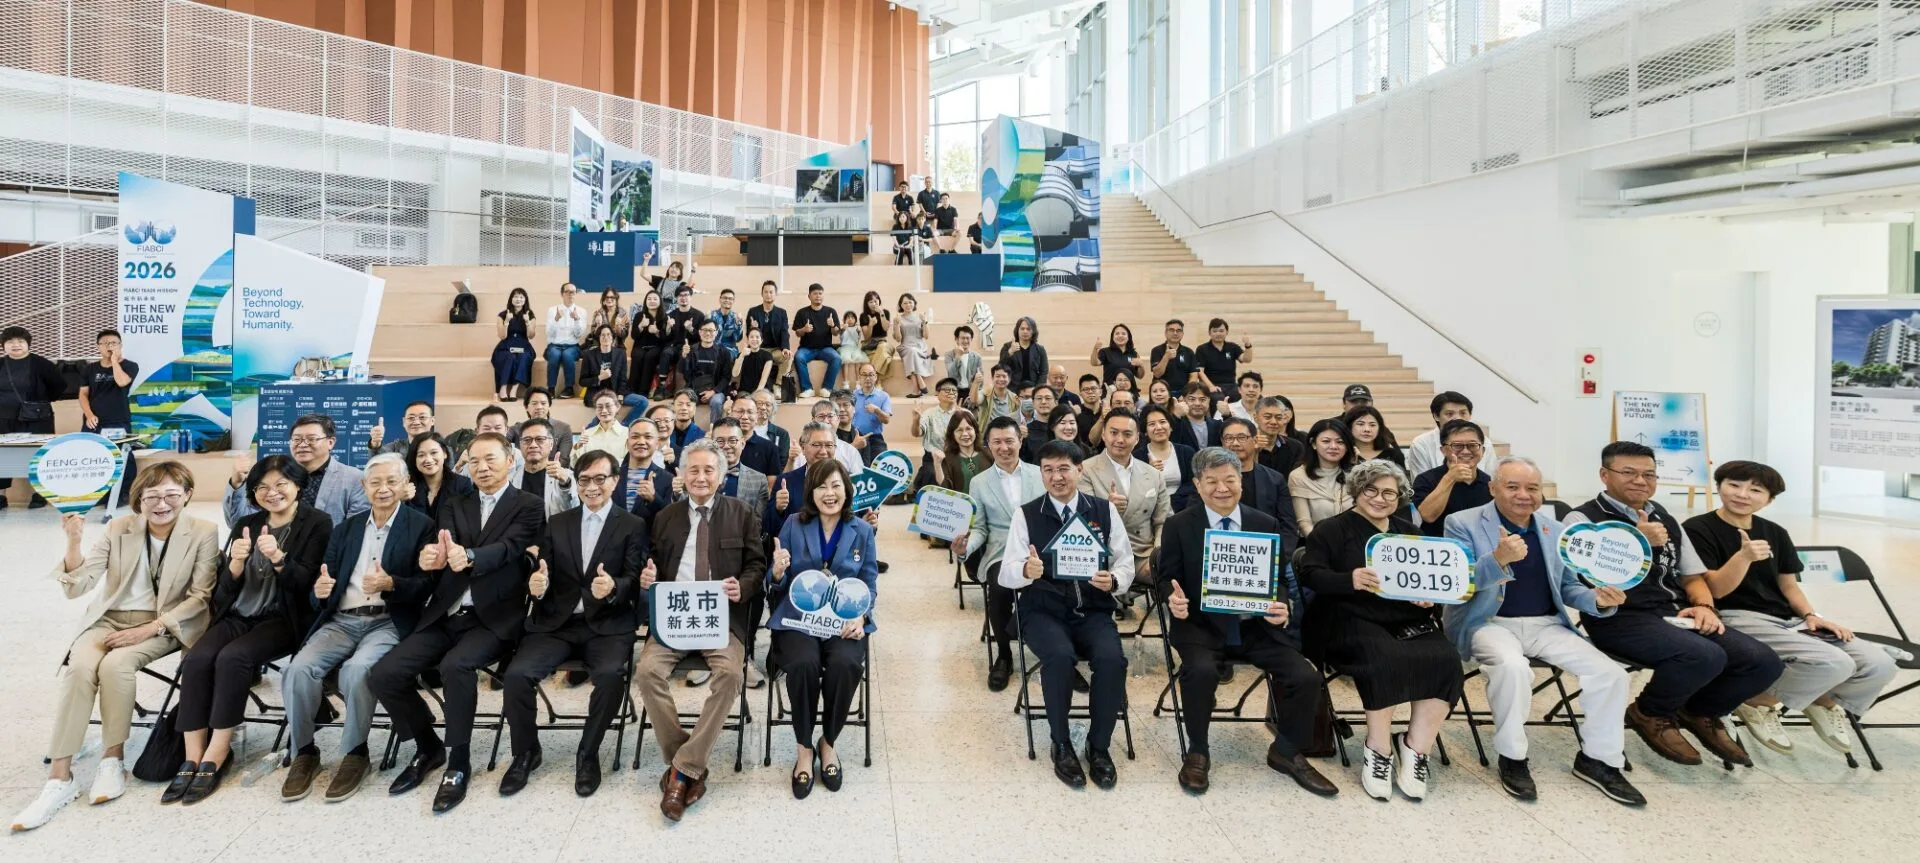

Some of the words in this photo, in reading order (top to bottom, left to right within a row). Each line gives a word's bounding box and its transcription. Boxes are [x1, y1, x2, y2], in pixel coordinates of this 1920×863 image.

[137, 245, 164, 253] FIABCI
[124, 262, 177, 279] 2026
[243, 288, 283, 300] Beyond
[124, 304, 146, 313] THE
[149, 304, 176, 313] NEW
[243, 309, 281, 319] Toward
[124, 315, 164, 323] URBAN
[123, 325, 169, 334] FUTURE
[243, 320, 295, 331] Humanity.
[46, 458, 78, 467] FENG
[81, 457, 110, 465] CHIA
[880, 461, 905, 478] 2026
[928, 495, 954, 507] Beyond
[925, 510, 949, 521] Toward
[1062, 534, 1094, 546] 2026
[1571, 536, 1595, 550] 城市
[1601, 537, 1630, 549] Beyond
[1213, 542, 1237, 553] THE
[1240, 544, 1268, 555] NEW
[1212, 553, 1255, 564] URBAN
[1381, 554, 1393, 562] 26
[1396, 546, 1451, 567] 09.12
[1597, 552, 1624, 565] Toward
[1211, 563, 1260, 575] FUTURE
[1210, 576, 1267, 588] 城市新未來
[1397, 571, 1453, 592] 09.19
[667, 590, 719, 612] 城市
[1213, 599, 1236, 608] 09.12
[1245, 601, 1269, 610] 09.19
[667, 615, 720, 629] 新未來
[804, 613, 844, 630] FIABCI
